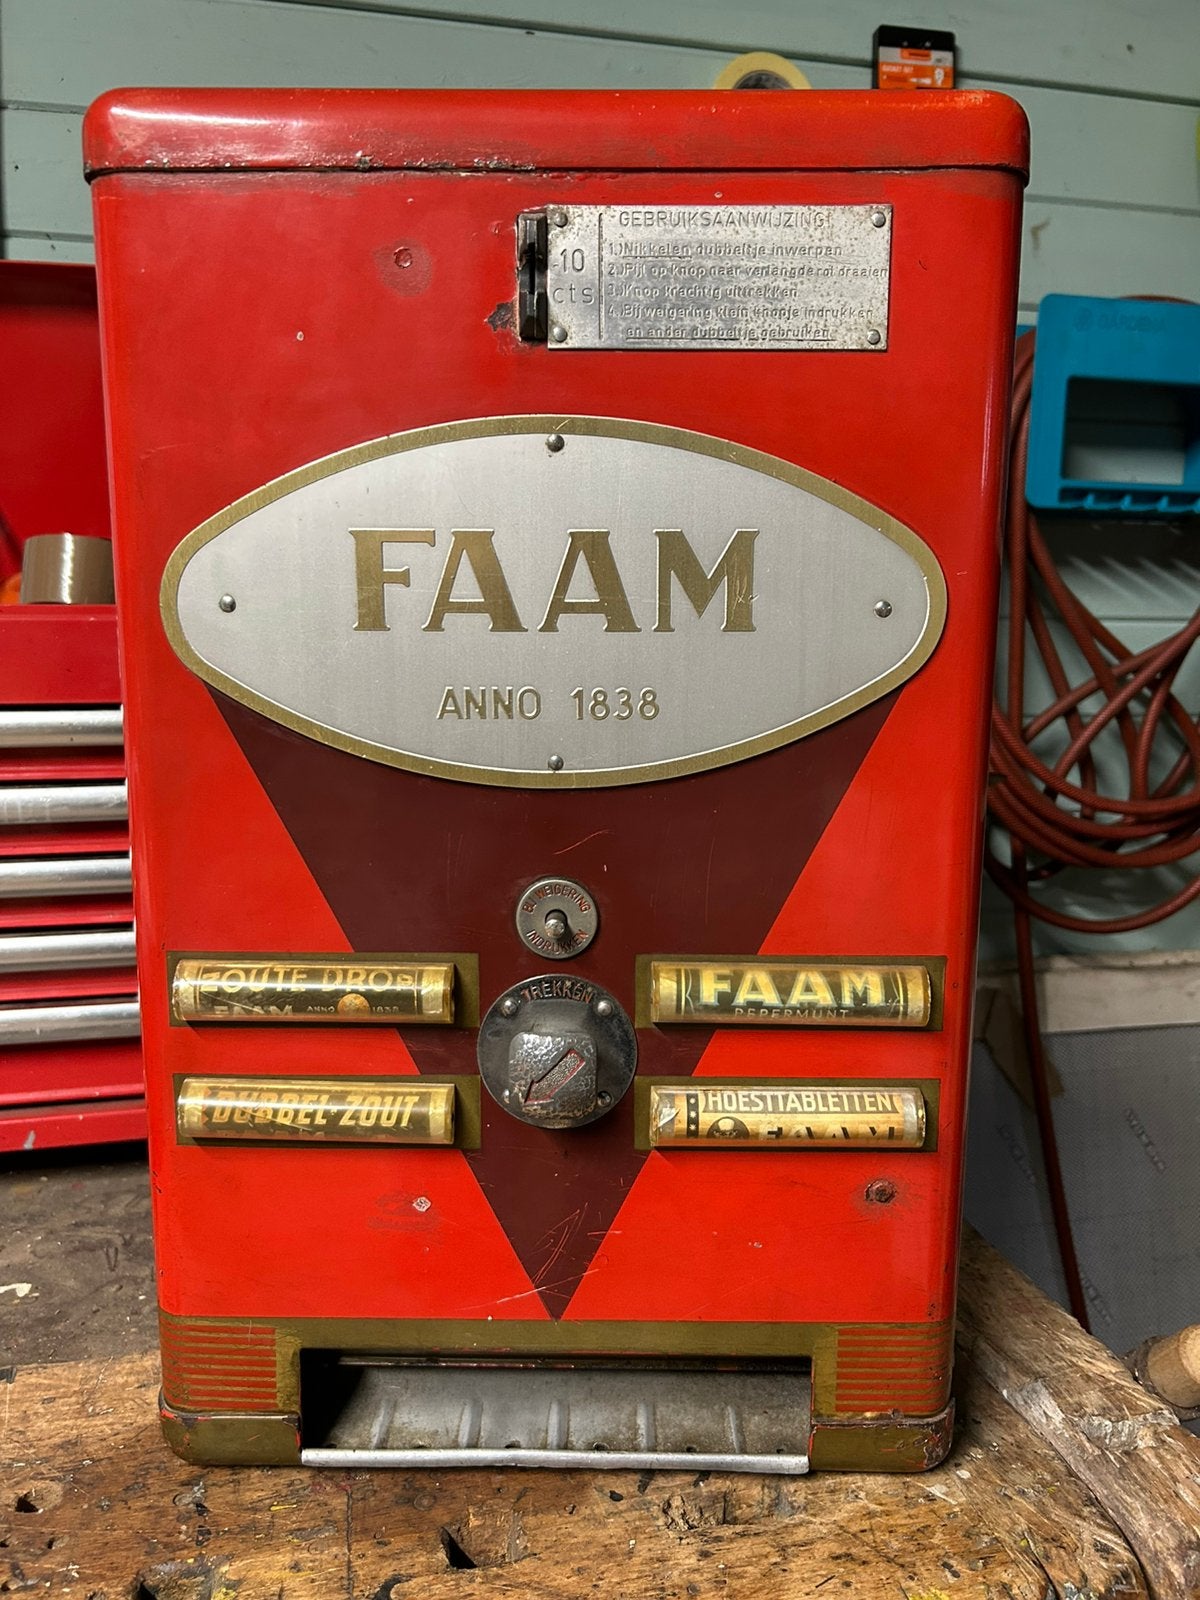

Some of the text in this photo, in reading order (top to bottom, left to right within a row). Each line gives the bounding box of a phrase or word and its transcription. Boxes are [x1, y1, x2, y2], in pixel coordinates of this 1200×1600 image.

[696, 242, 767, 258] dubbeltje
[552, 284, 596, 305] cts
[348, 527, 760, 633] FAAM
[436, 686, 661, 721] ANNO 1838
[519, 979, 594, 1005] TREKKEN
[699, 967, 887, 1008] FAAM
[734, 1007, 850, 1020] PEPERMUNT
[706, 1090, 892, 1113] HOESTTABLETTEN
